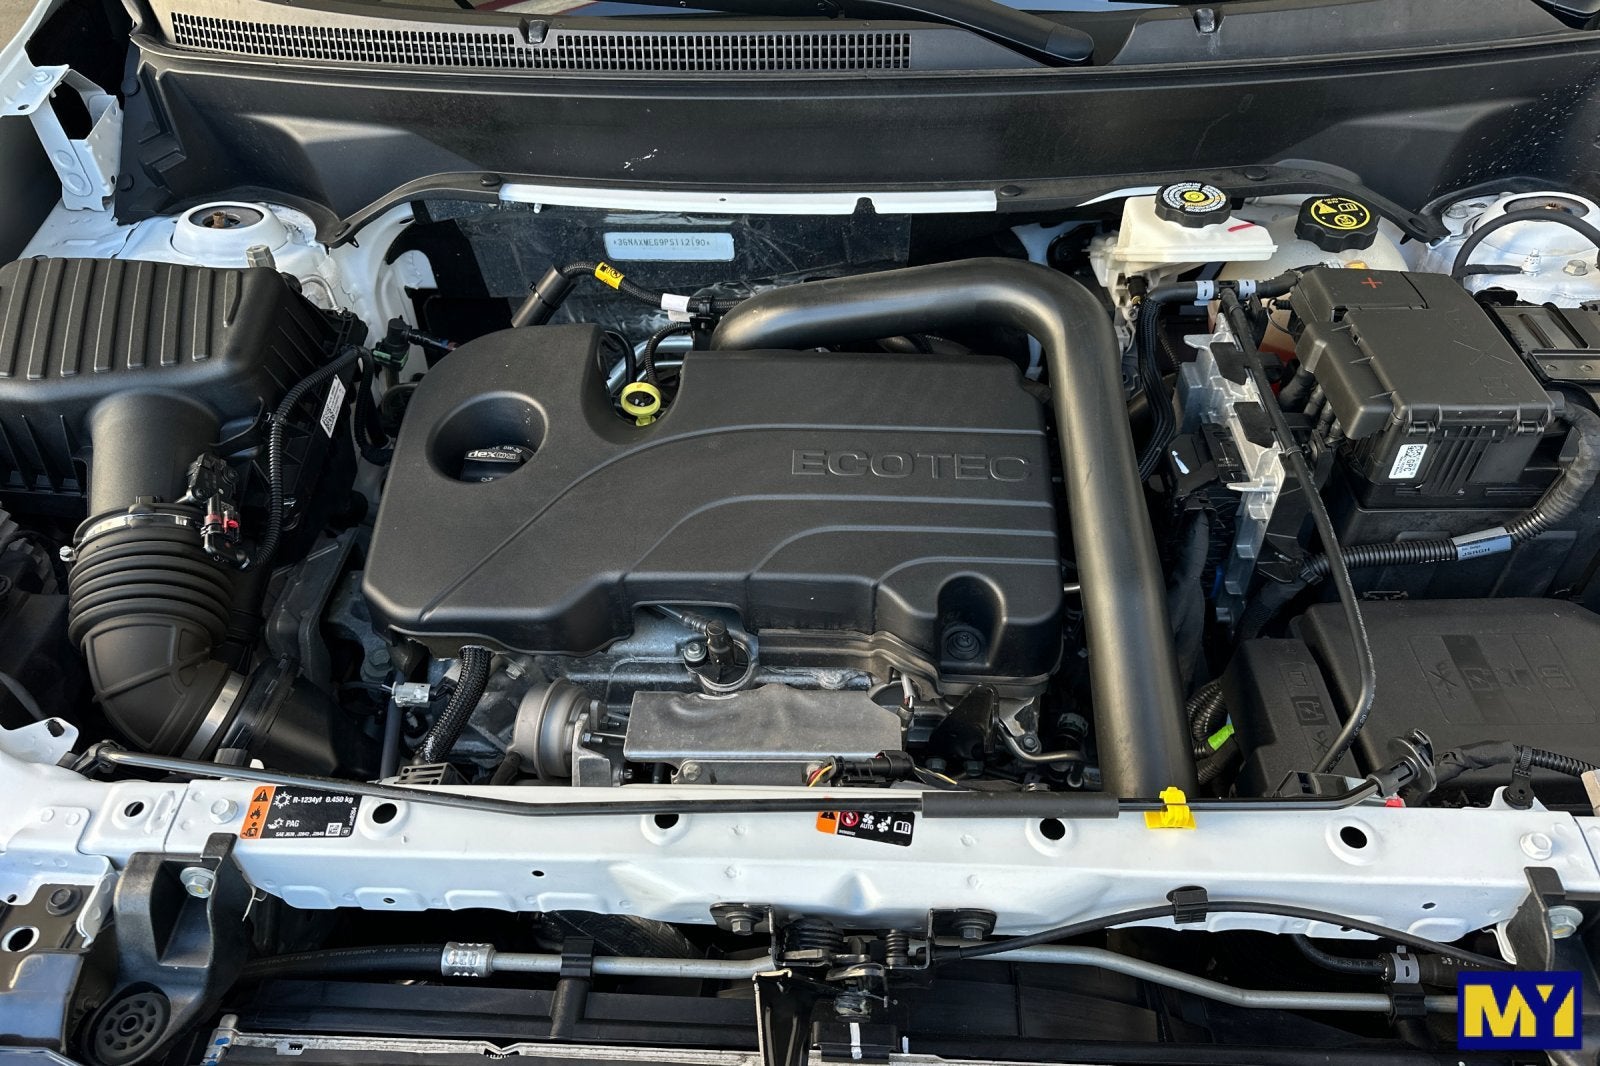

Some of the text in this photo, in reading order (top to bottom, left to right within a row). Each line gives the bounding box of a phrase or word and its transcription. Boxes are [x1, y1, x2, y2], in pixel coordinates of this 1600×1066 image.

[467, 450, 517, 460] dexos
[791, 449, 1032, 483] ECOTEC
[292, 796, 354, 805] R-1234yf 0.450 kg
[285, 820, 300, 828] PAG
[860, 823, 875, 831] AUTO
